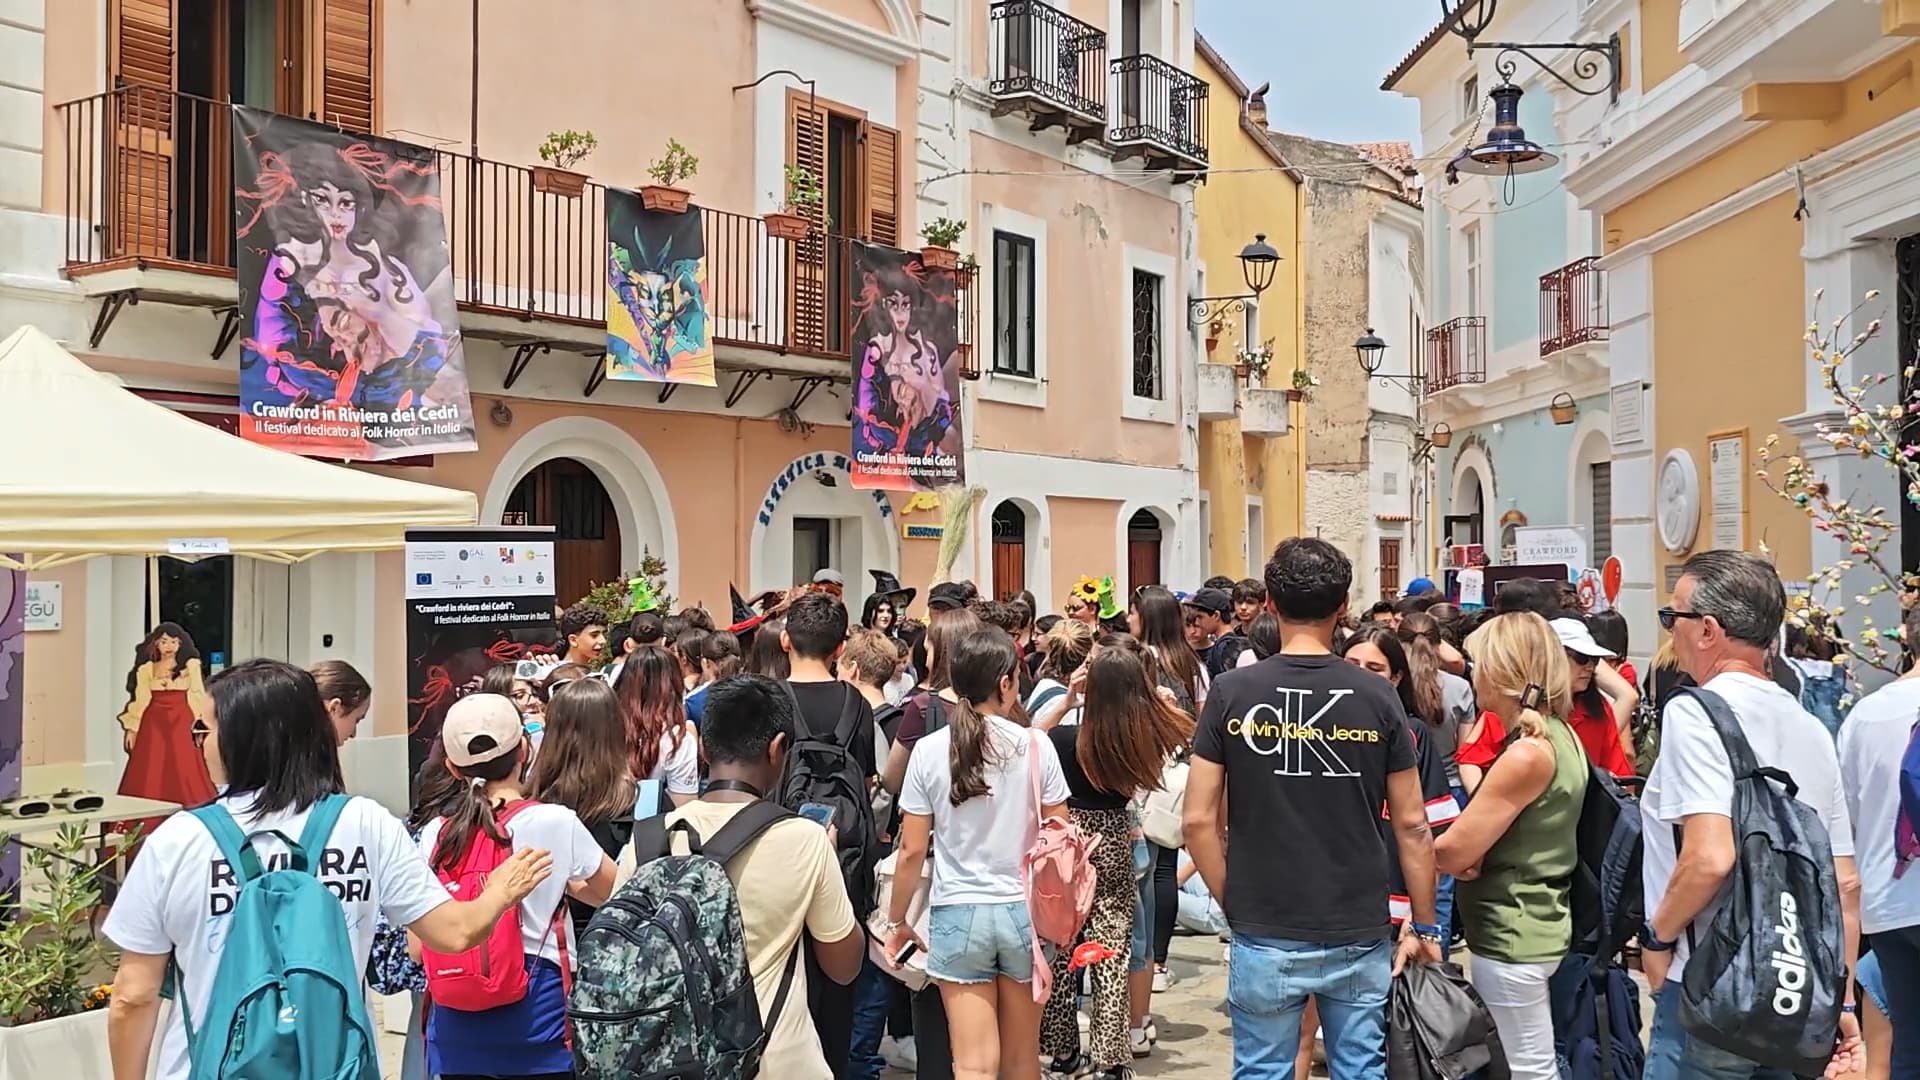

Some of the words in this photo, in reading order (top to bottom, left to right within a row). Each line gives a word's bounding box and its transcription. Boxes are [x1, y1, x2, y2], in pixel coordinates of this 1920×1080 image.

[253, 400, 320, 420] Crawford
[322, 405, 336, 421] in
[338, 406, 389, 424] Riviera
[391, 407, 416, 423] dei
[418, 403, 459, 421] Cedri
[264, 420, 301, 435] festival
[303, 423, 349, 438] dedicato
[350, 425, 360, 438] al
[362, 425, 383, 439] Folk
[384, 425, 419, 438] Horror
[421, 424, 432, 435] in
[433, 421, 461, 434] Italia
[857, 450, 888, 464] Crawford
[889, 453, 896, 464] in
[897, 453, 921, 466] Riviera
[922, 455, 934, 467] dei
[935, 455, 957, 467] Cedri
[1227, 718, 1280, 738] Calvin
[1281, 721, 1324, 741] Klein
[1326, 724, 1379, 742] Jeans
[1771, 891, 1807, 1016] adidas
